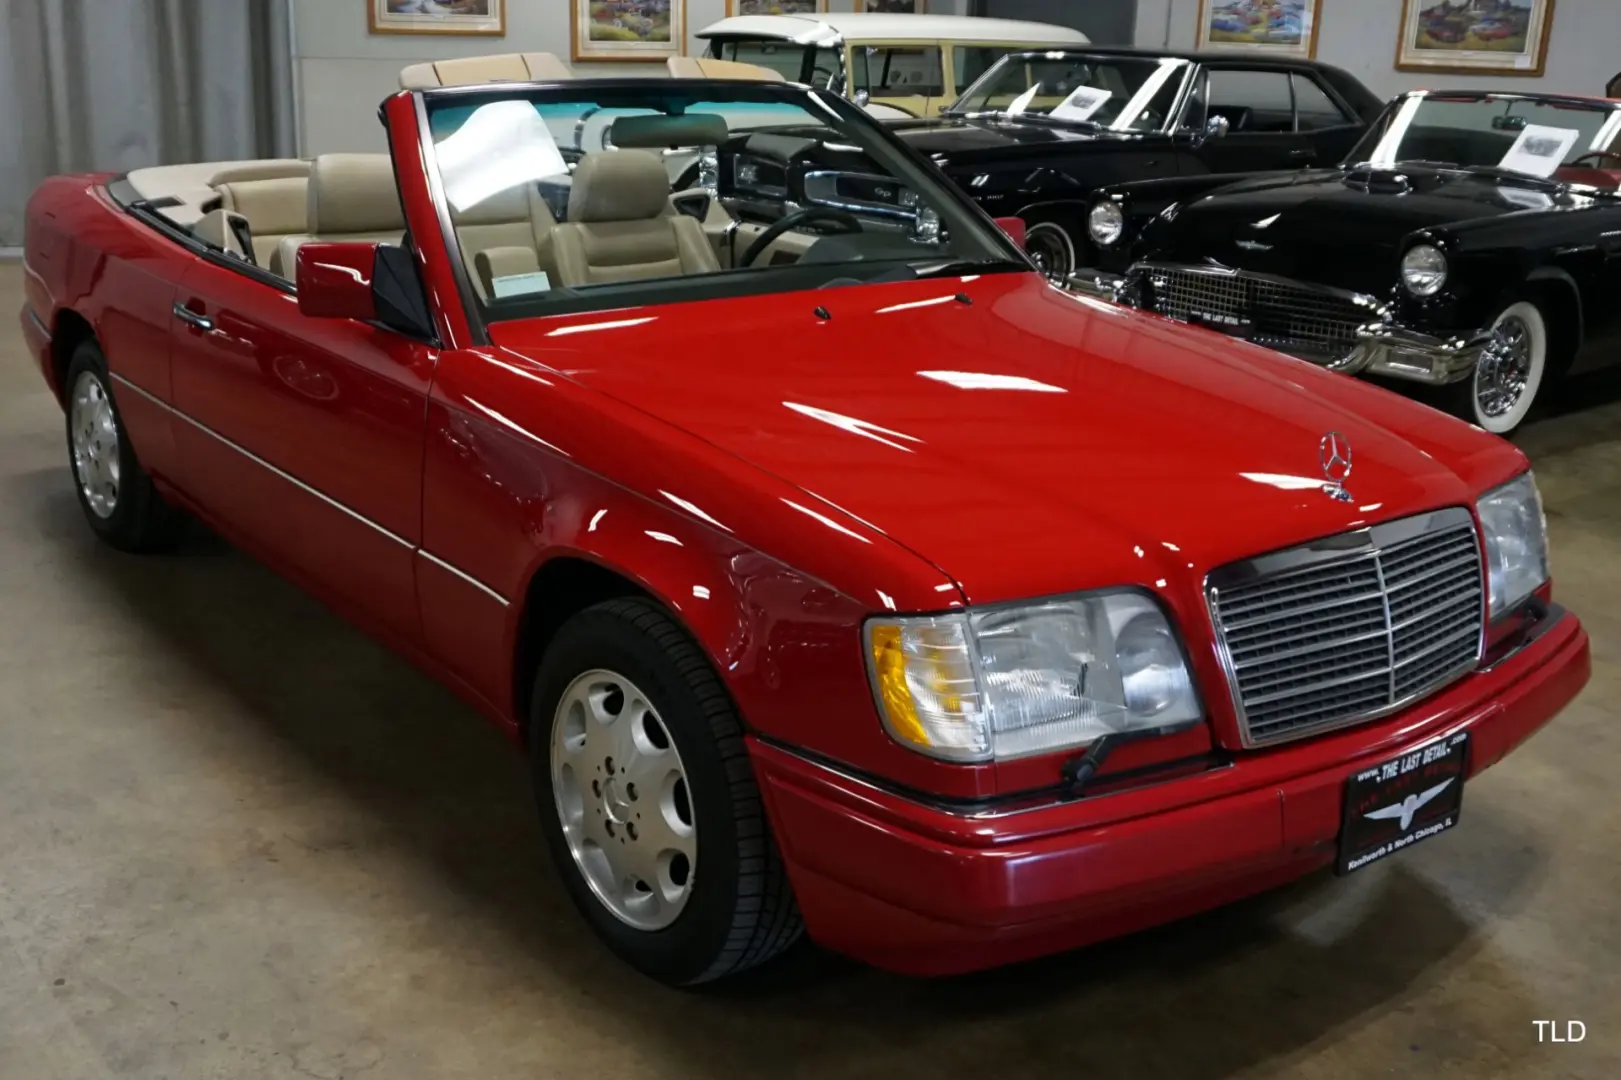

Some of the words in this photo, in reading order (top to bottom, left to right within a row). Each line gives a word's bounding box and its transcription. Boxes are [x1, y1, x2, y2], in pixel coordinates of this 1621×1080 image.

[1382, 760, 1399, 780] THE
[1401, 753, 1421, 774] LAST
[1422, 741, 1448, 765] DETAIL
[1347, 847, 1386, 870] Kenilworth
[1387, 843, 1393, 852] &
[1394, 834, 1414, 849] North
[1415, 823, 1444, 839] Chicago,
